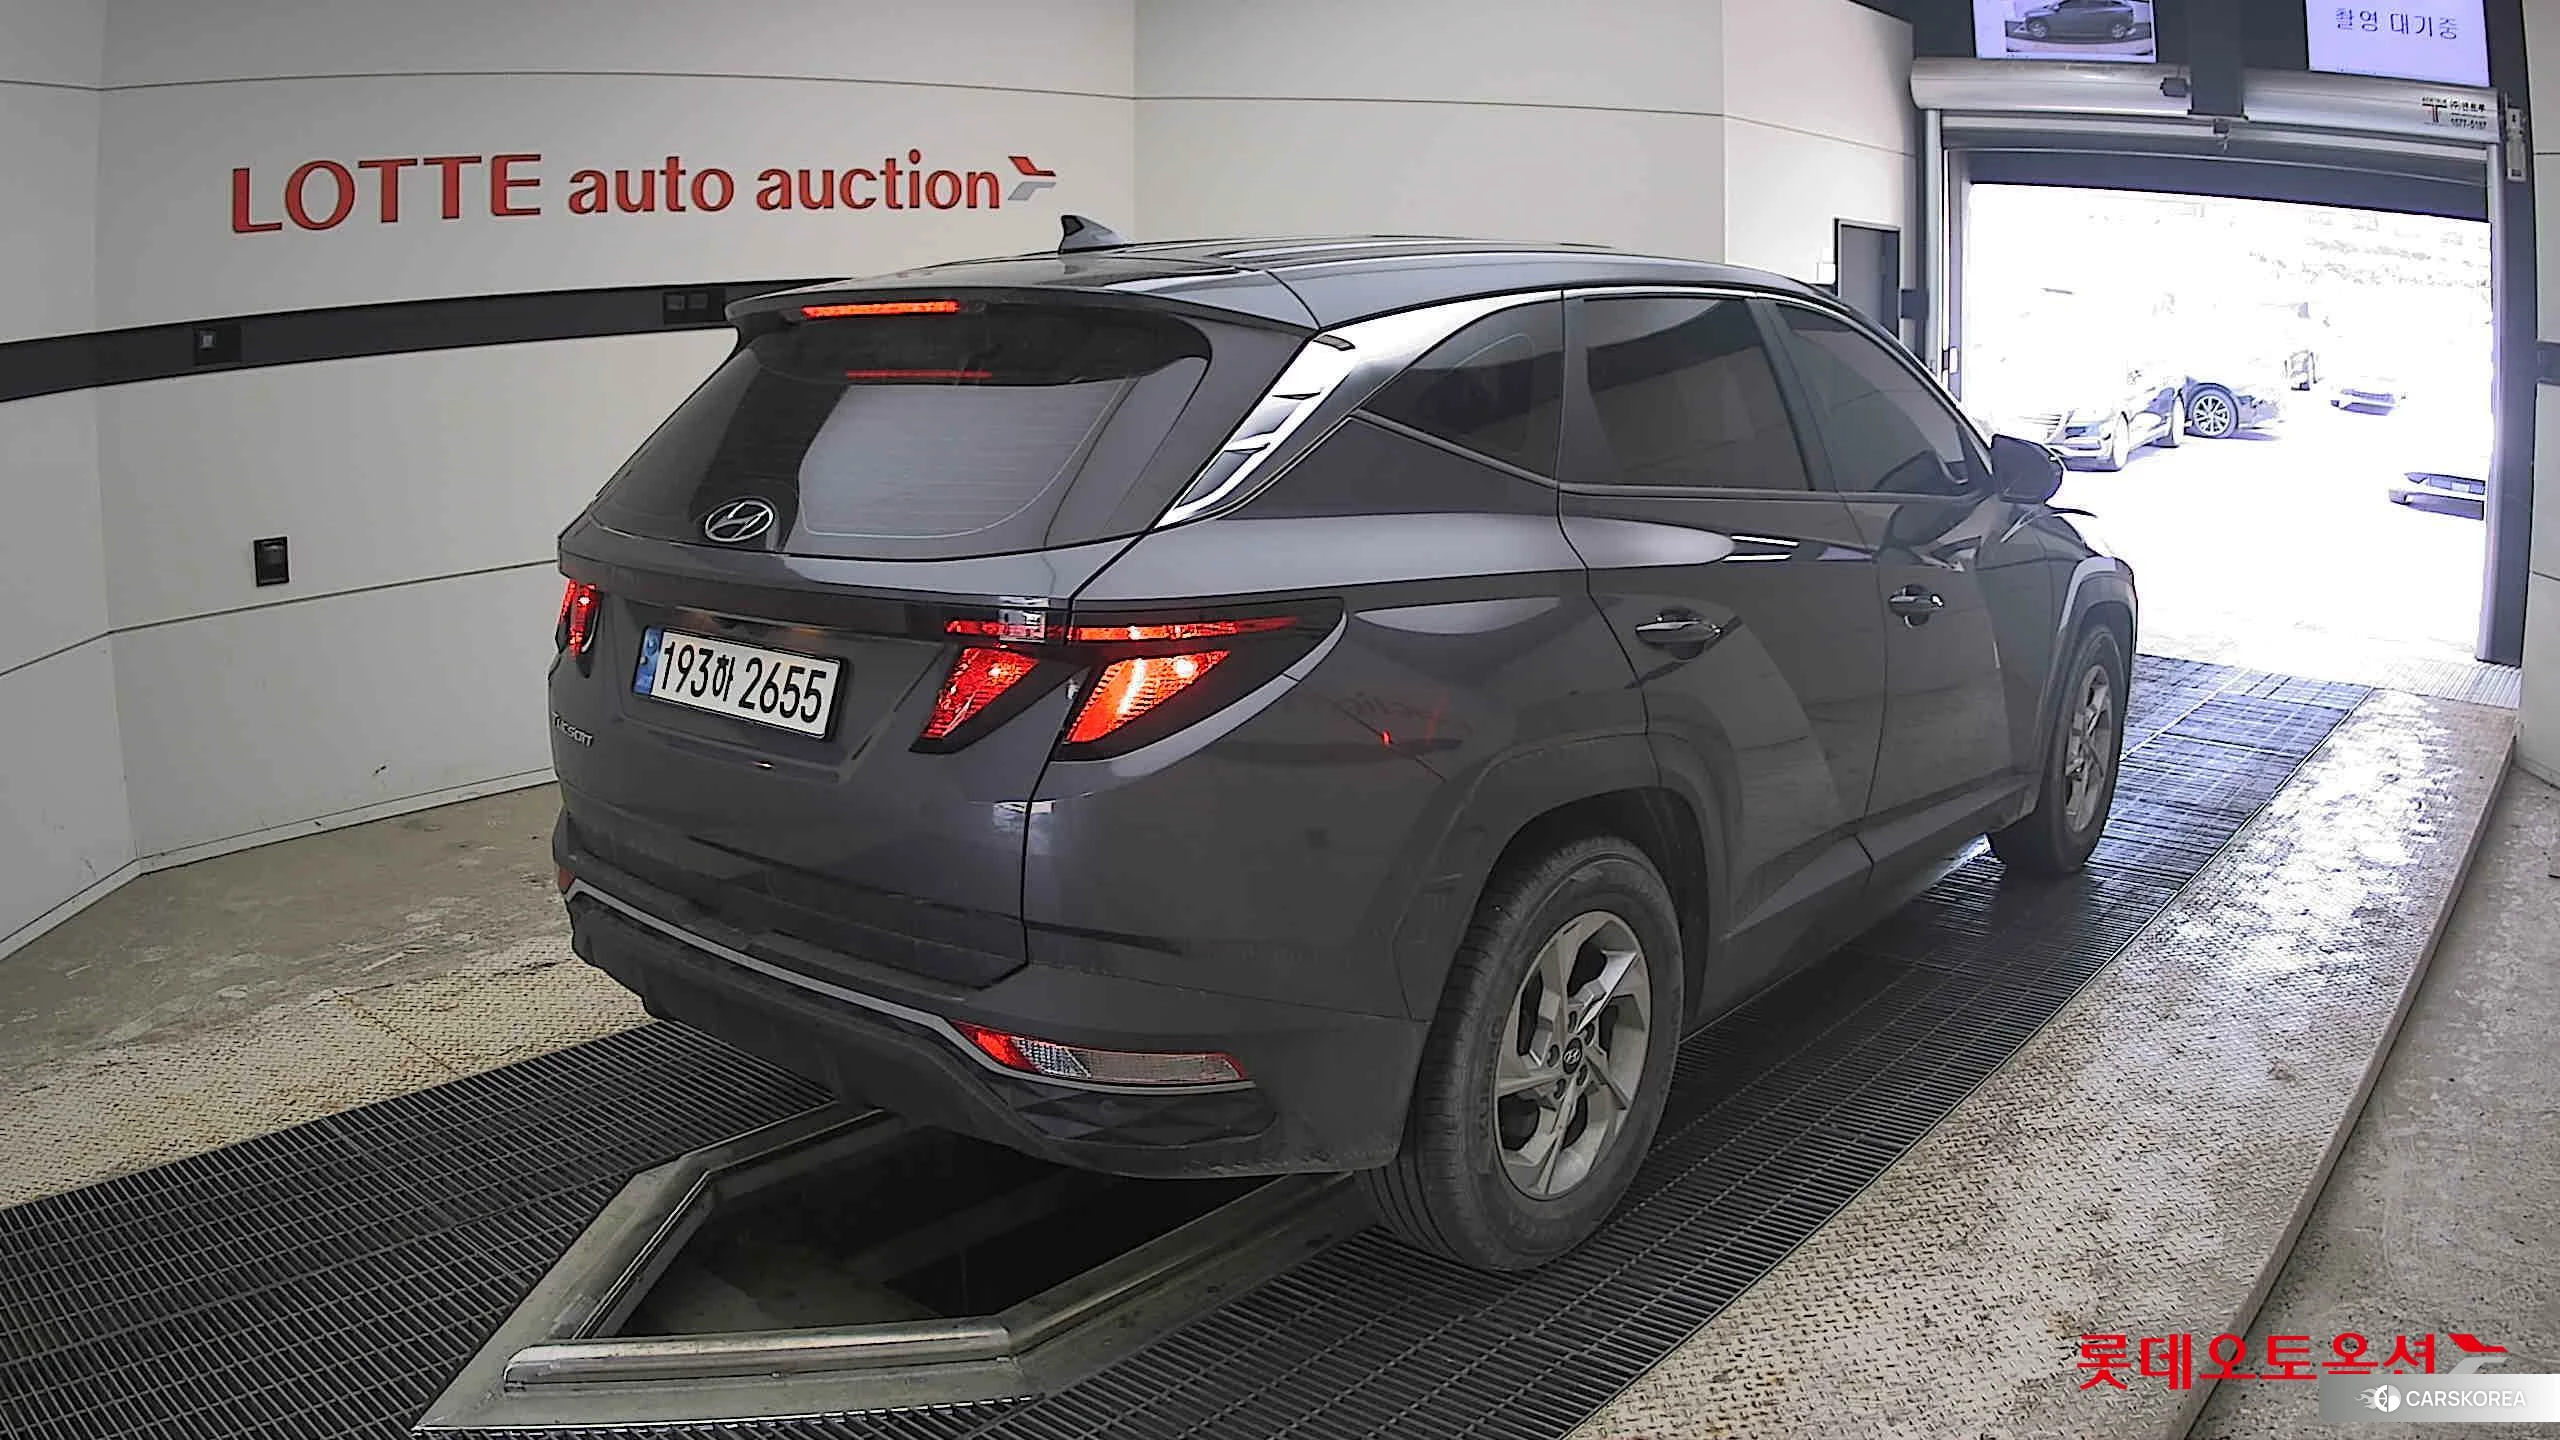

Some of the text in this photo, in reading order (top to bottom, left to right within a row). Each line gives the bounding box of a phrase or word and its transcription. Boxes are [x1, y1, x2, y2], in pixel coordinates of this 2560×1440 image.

[2336, 8, 2457, 40] 촬영 대기중
[233, 149, 1002, 232] LOTTE auto auction
[662, 640, 827, 724] 193하 2655
